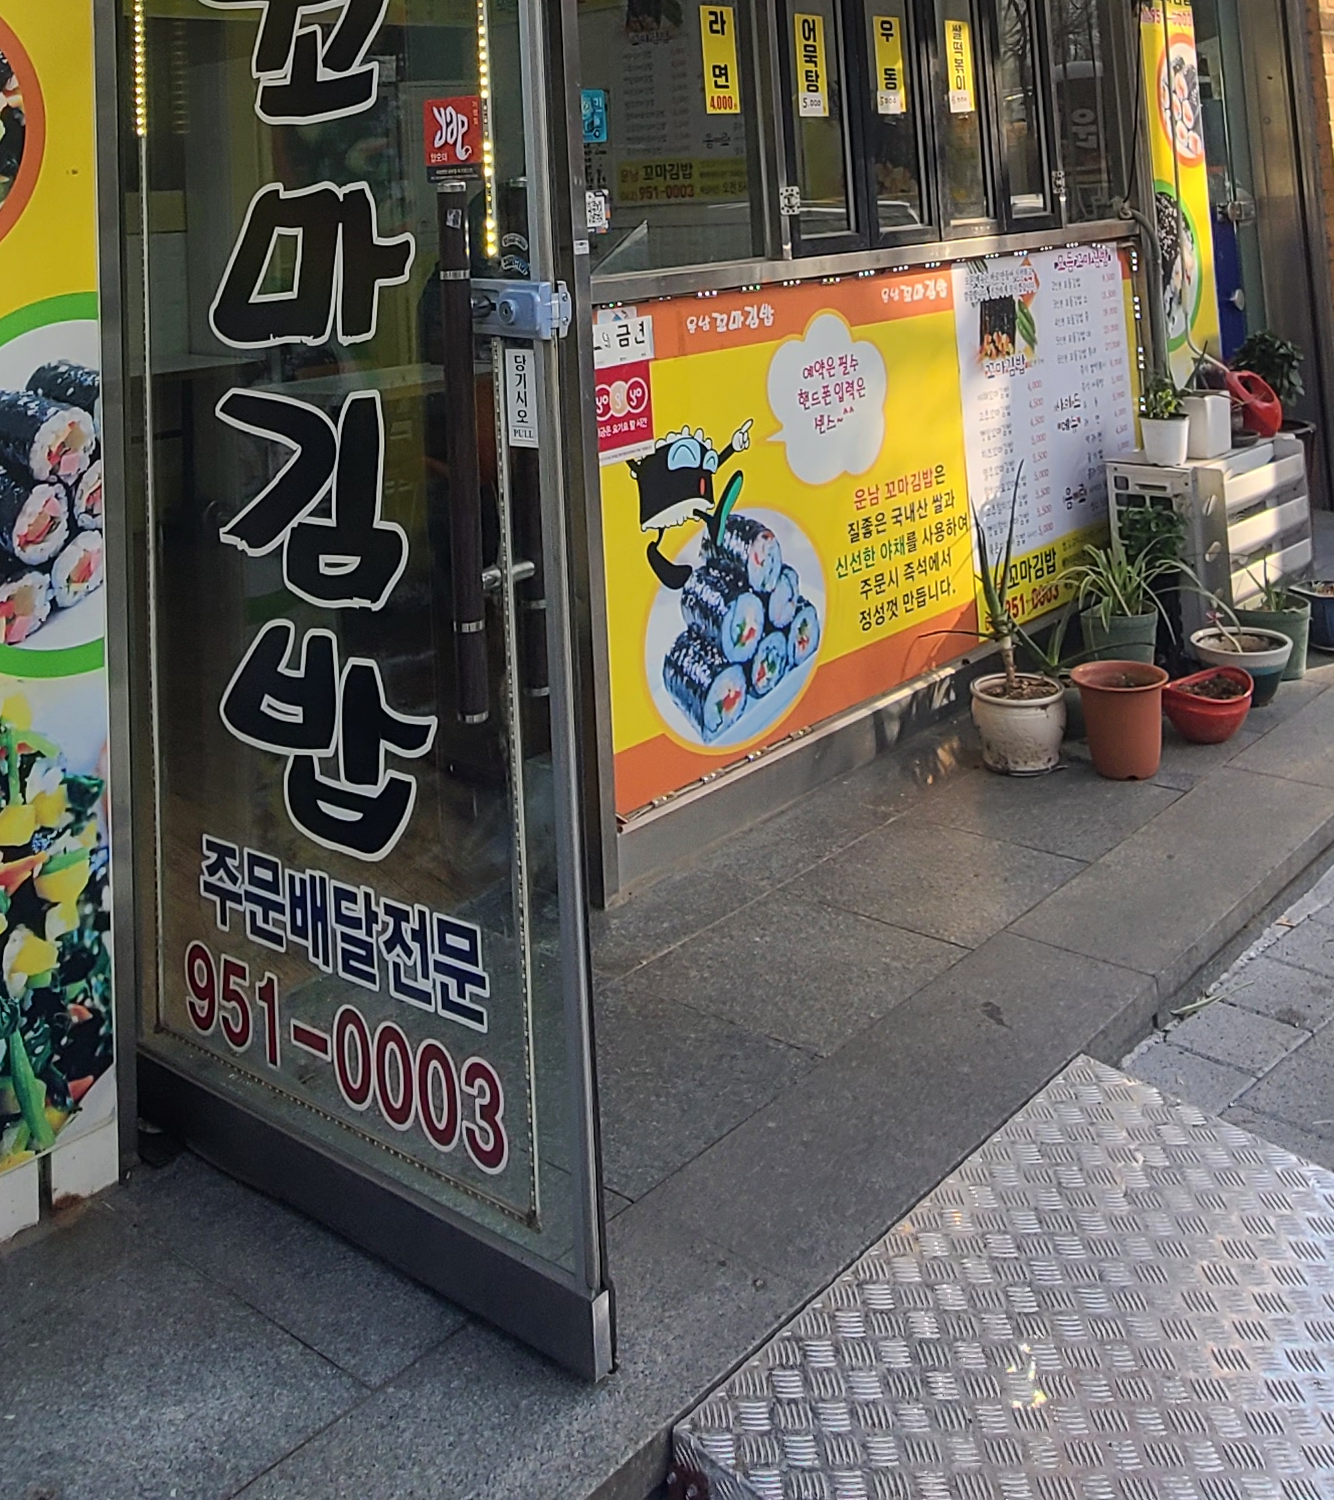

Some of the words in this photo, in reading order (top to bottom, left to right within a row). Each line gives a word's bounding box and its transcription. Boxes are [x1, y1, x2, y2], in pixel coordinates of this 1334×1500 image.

[708, 10, 730, 89] 라면
[801, 18, 820, 94] 어묵탕
[880, 20, 898, 91] 우동
[642, 161, 694, 182] 꼬마김밥
[900, 278, 948, 302] 꼬마김밥
[712, 303, 775, 333] 꼬마김밥
[513, 354, 529, 425] 당기시오
[802, 356, 836, 380] 예약은
[838, 354, 859, 377] 필수
[797, 384, 832, 411] 핸드폰
[834, 377, 866, 403] 입력은
[512, 428, 534, 440] PULL
[854, 484, 880, 511] 운남
[884, 464, 946, 501] 꼬마김밥은
[891, 498, 928, 527] 국내산
[931, 489, 956, 514] 쌀과
[835, 545, 876, 579] 신선한
[880, 530, 918, 561] 야채를
[922, 512, 969, 547] 사용하여
[1007, 547, 1057, 590] 꼬마김밥
[860, 566, 899, 600] 주문시
[903, 547, 952, 582] 즉석에서
[859, 596, 899, 632] 정성껏
[902, 576, 956, 613] 만듭니다.
[198, 832, 492, 1035] 주문배달전문
[184, 940, 511, 1177] 951-0003
